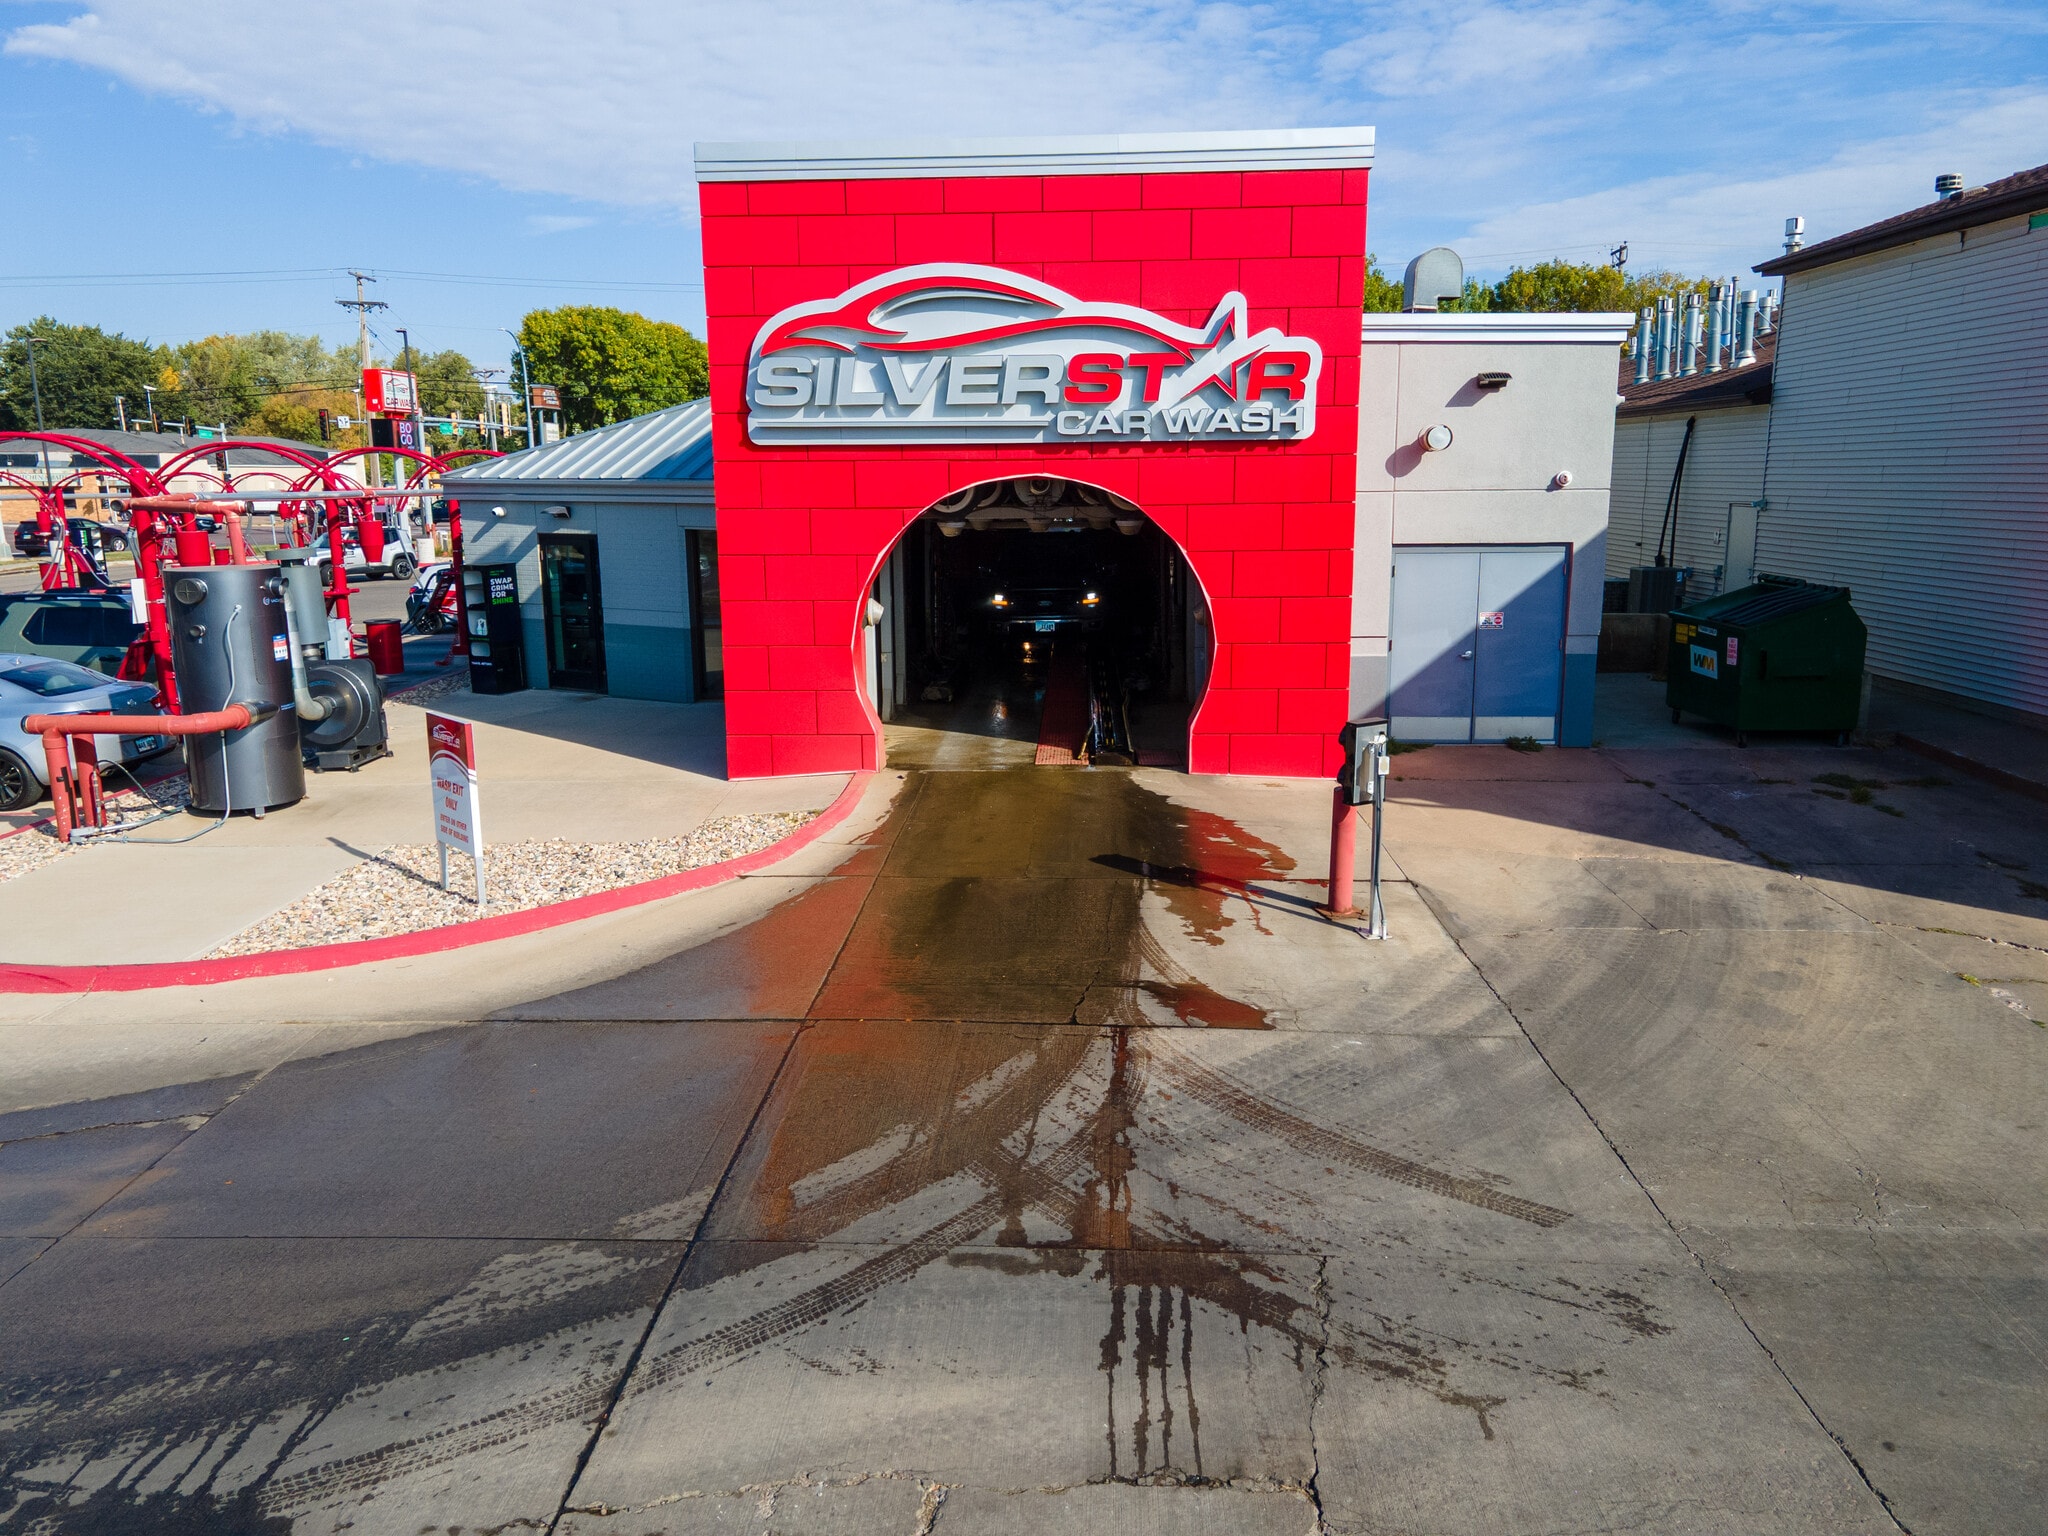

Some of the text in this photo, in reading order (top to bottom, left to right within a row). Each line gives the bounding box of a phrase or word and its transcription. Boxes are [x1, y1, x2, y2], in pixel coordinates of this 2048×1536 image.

[754, 350, 1312, 406] SILVERSTAR
[1056, 407, 1305, 437] CAR WASH
[490, 577, 512, 585] SWAP
[490, 583, 514, 592] GRIME
[491, 591, 507, 599] FOR
[492, 596, 514, 605] SHINE
[1693, 652, 1715, 672] WM
[437, 776, 464, 797] WASH EXIT
[445, 797, 458, 811] ONLY
